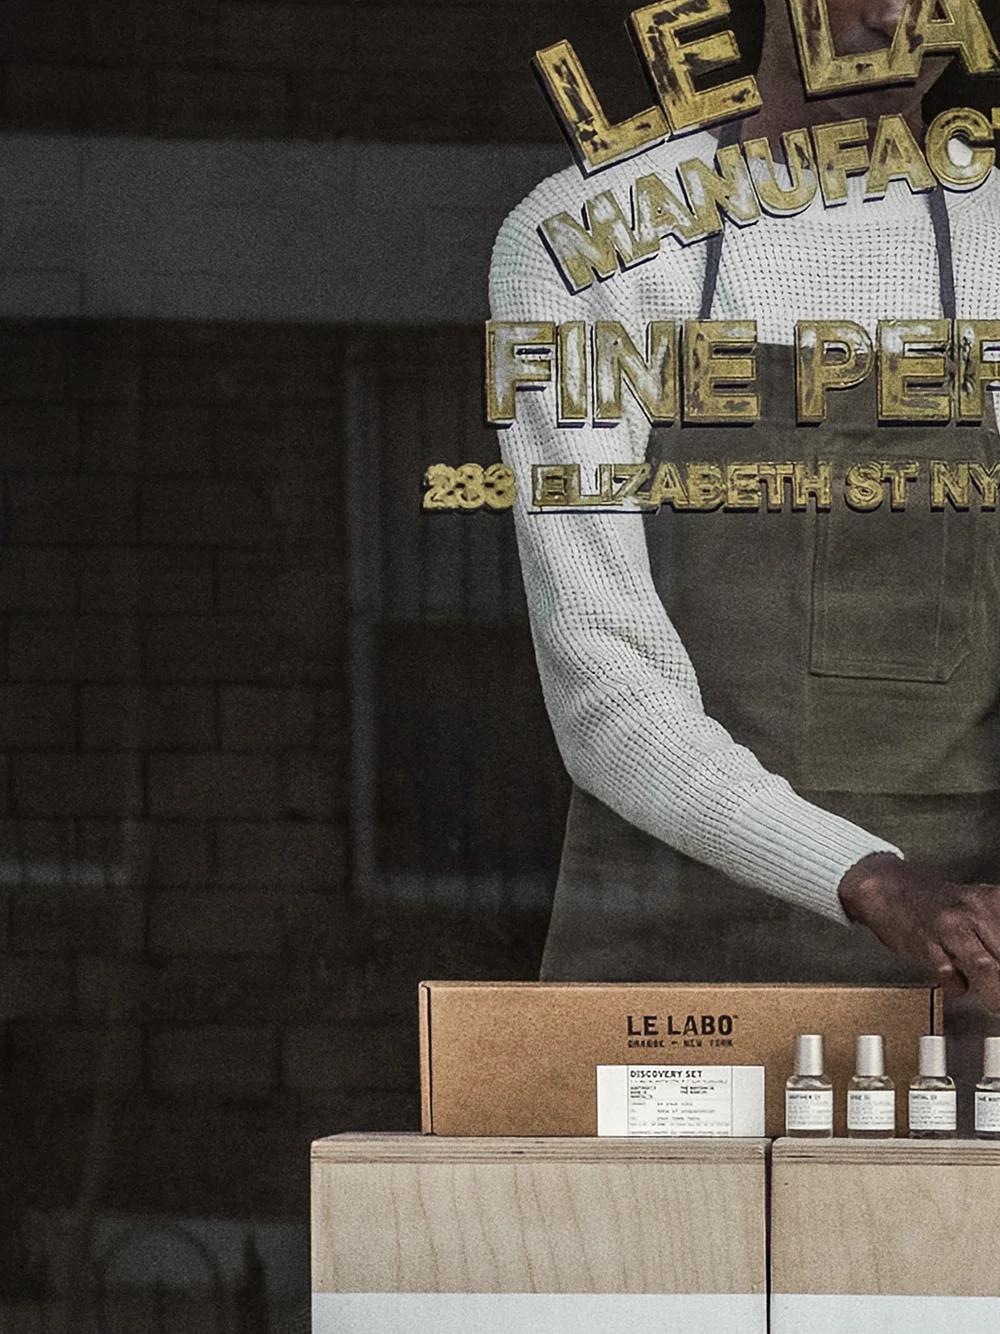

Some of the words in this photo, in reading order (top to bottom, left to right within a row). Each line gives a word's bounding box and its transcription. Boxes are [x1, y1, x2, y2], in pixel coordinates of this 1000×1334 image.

[533, 0, 763, 172] LE
[484, 319, 762, 426] FINE
[530, 463, 833, 510] ELIZABETH
[845, 461, 919, 509] ST
[627, 1016, 659, 1036] LE
[667, 1015, 733, 1036] LABO
[630, 1070, 682, 1078] DISCOVERY
[685, 1070, 703, 1078] SET
